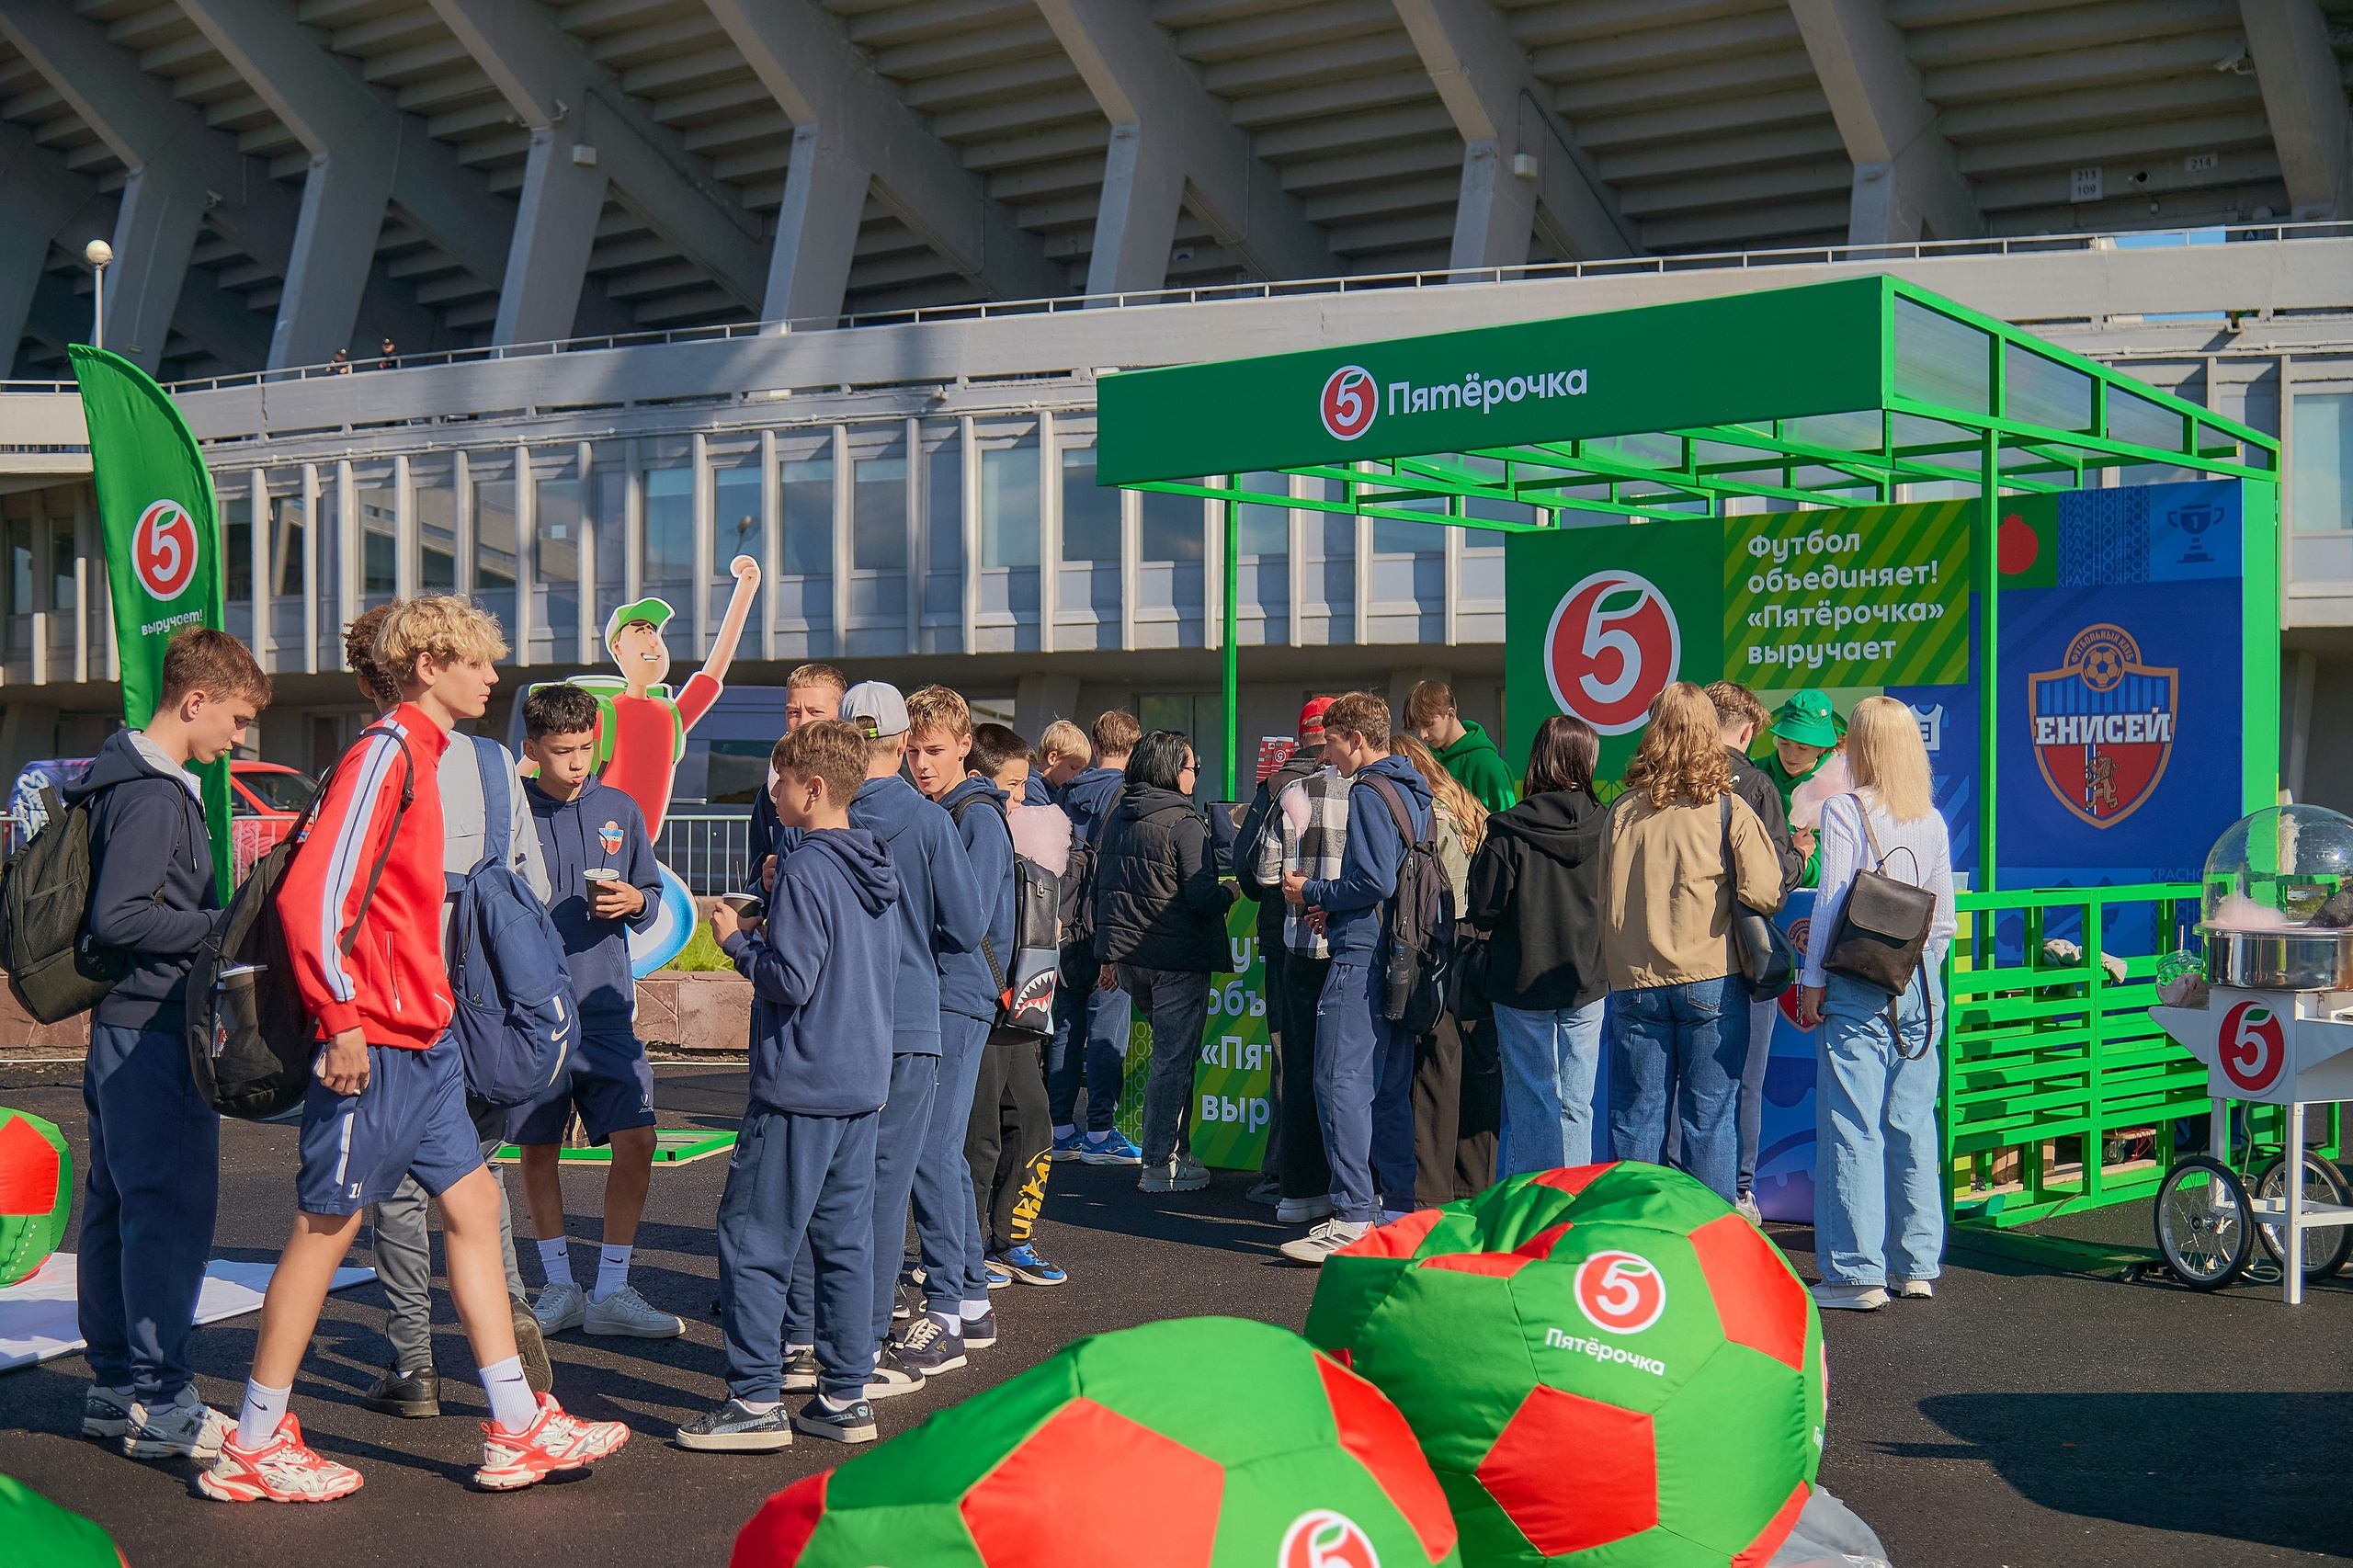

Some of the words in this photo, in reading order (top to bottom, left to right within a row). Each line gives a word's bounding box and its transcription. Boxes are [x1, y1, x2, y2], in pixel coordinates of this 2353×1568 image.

[1388, 369, 1587, 415] Пятёрочка
[1747, 528, 1860, 563] Футбол
[1747, 560, 1938, 594] объединяет!
[141, 608, 203, 636] выручает!
[1747, 599, 1945, 631] «Пятёрочка»
[1748, 640, 1897, 669] выручает
[2071, 631, 2120, 663] ФУТБОЛЬНЫЙ
[2120, 637, 2134, 660] КЛУБ
[2035, 706, 2172, 745] ЕНИСЕЙ
[1545, 1326, 1665, 1376] Пятёрочка
